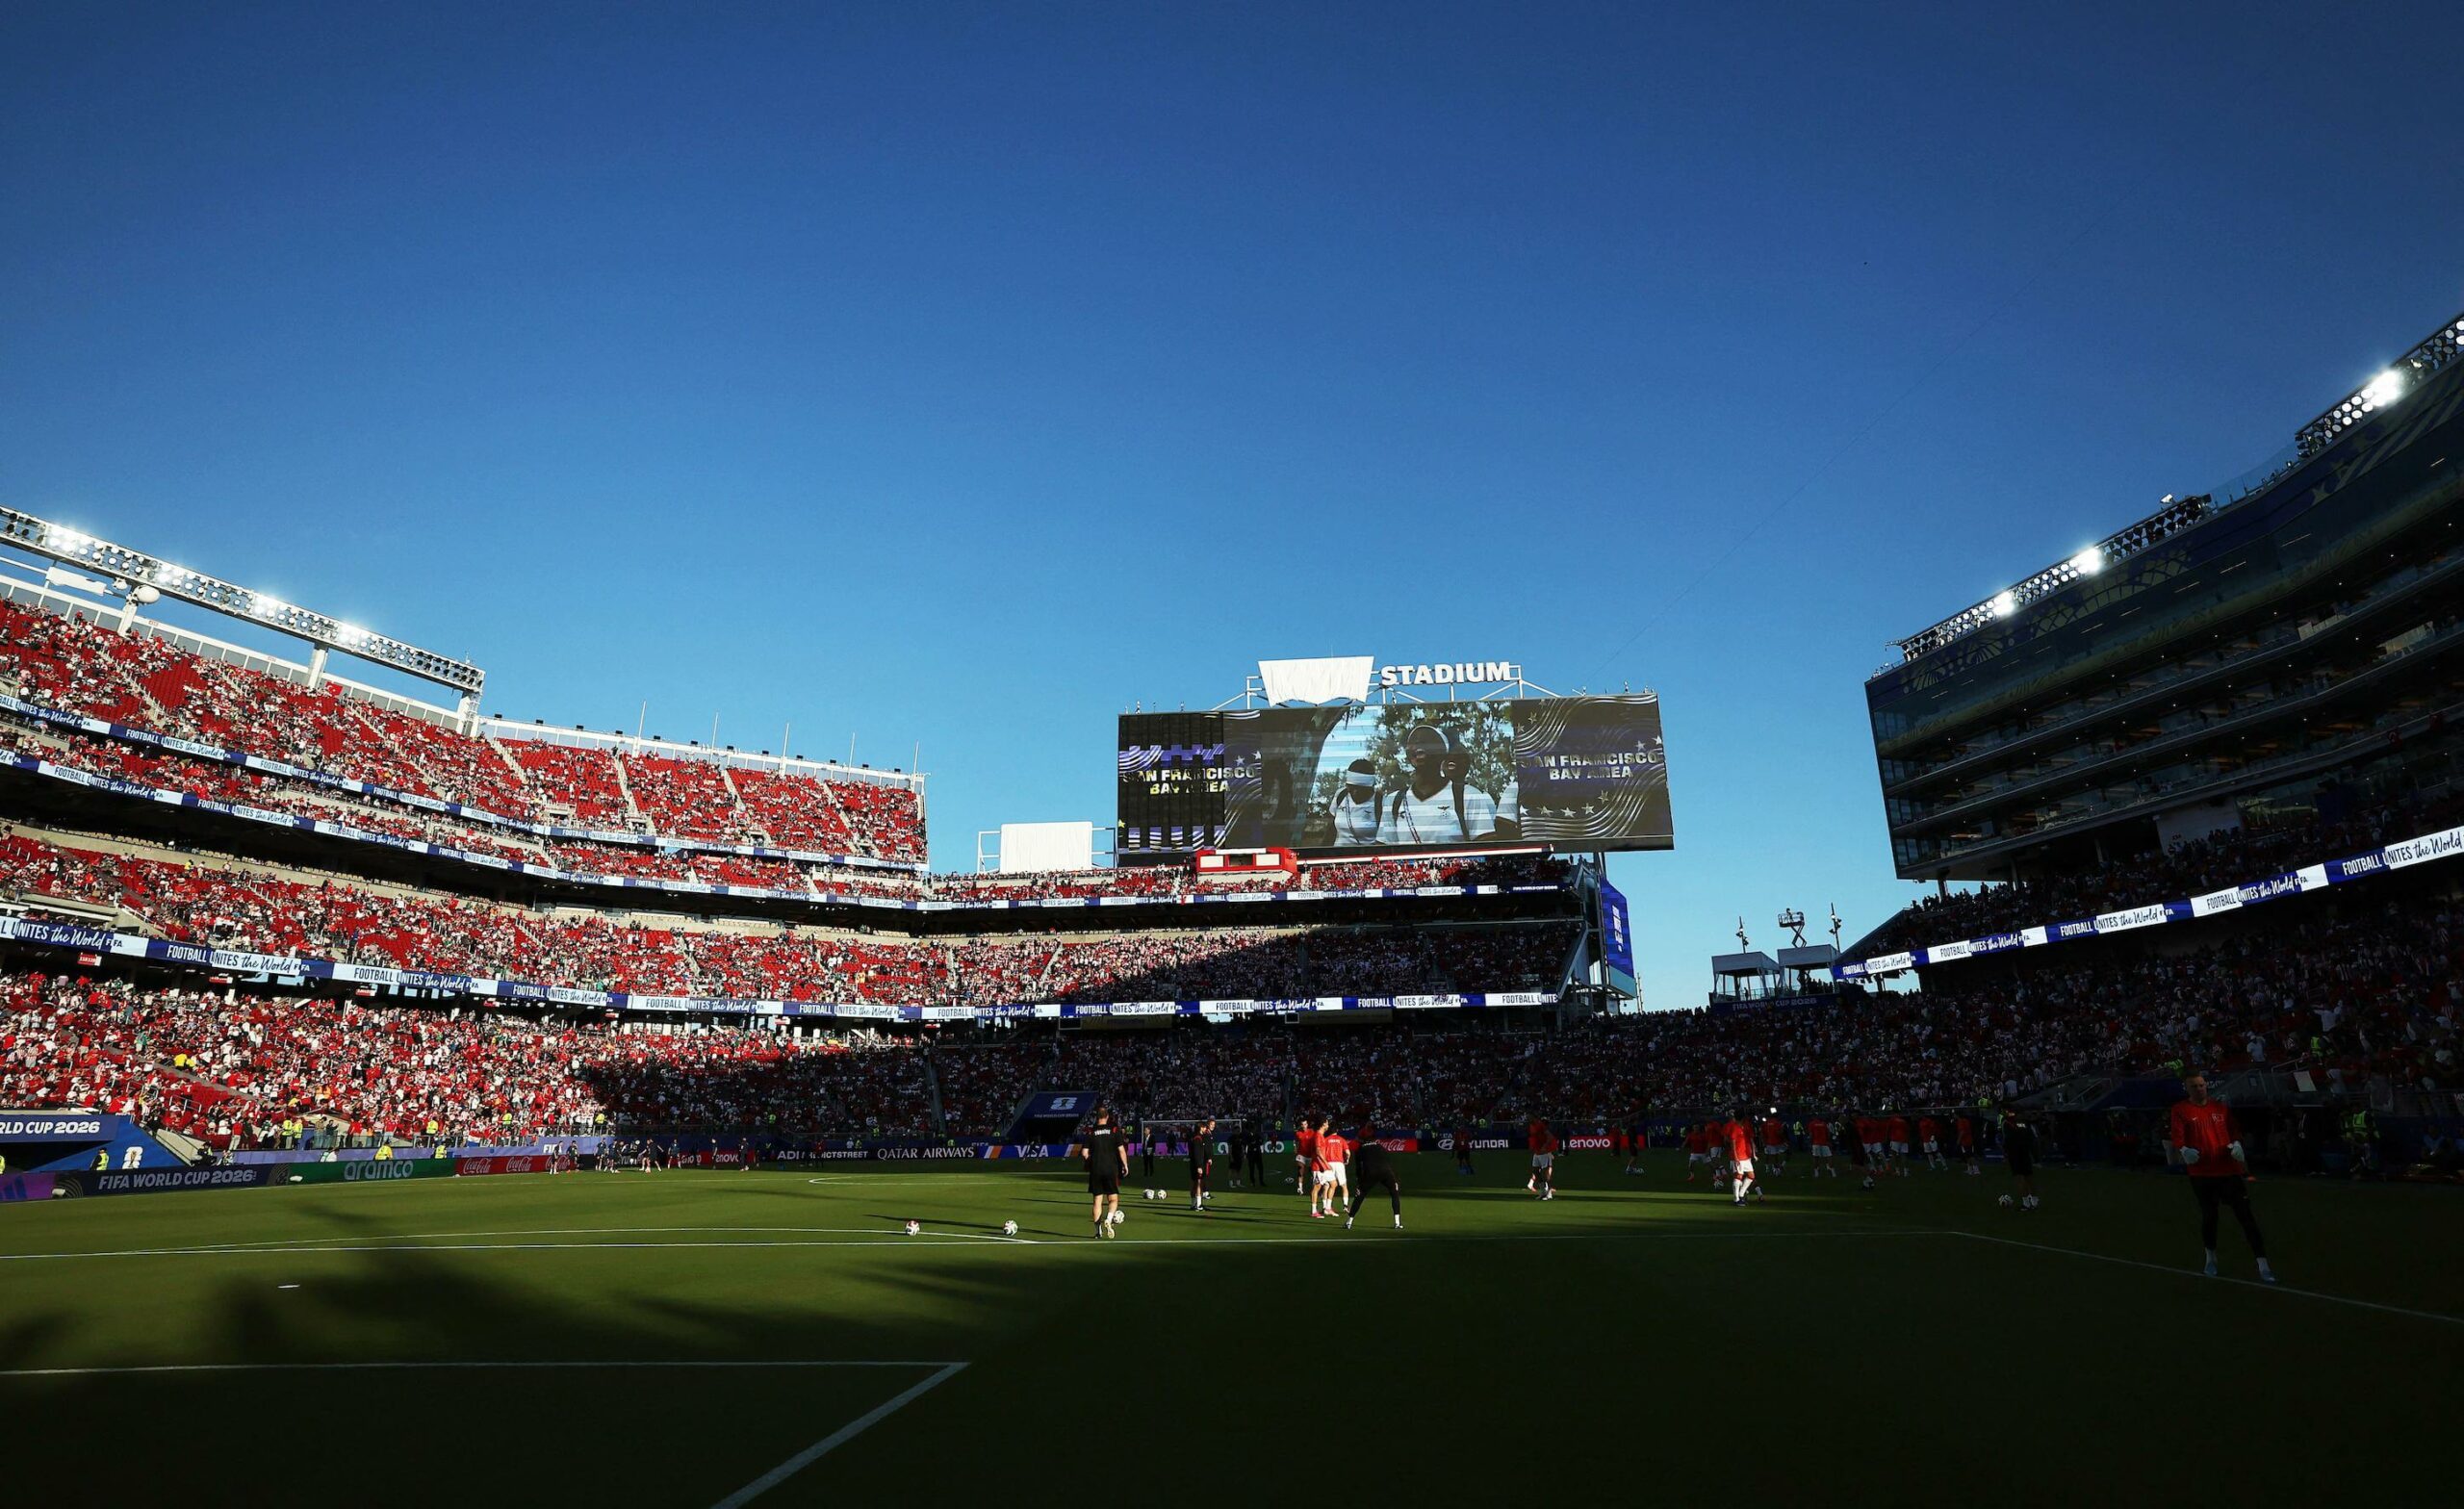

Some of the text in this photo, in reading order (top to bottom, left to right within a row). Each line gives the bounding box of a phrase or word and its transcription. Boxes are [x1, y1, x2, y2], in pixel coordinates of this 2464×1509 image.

[1381, 662, 1509, 685] STADIUM
[15, 701, 77, 725] UNITES the World
[126, 729, 159, 744] FOOTBALL
[162, 736, 184, 749] UNITES
[196, 744, 221, 757] World
[260, 759, 288, 773] FOOTBALL
[1559, 753, 1657, 767] FRANCISCO
[1549, 765, 1633, 780] BAY AREA
[54, 766, 151, 799] FOOTBALL UNITES the World
[372, 787, 398, 800] FOOTBALL
[197, 799, 230, 813] FOOTBALL
[232, 806, 254, 817] UNITES
[267, 811, 290, 825] World
[562, 829, 588, 838] FOOTBALL
[438, 847, 462, 859] FOOTBALL
[2342, 831, 2463, 876] FOOTBALL UNITES the World
[634, 880, 660, 889] FOOTBALL
[2206, 892, 2236, 910] FOOTBALL
[2236, 886, 2258, 903] UNITES
[2259, 881, 2272, 897] the
[2272, 875, 2295, 893] World
[2060, 922, 2093, 937] FOOTBALL
[2094, 917, 2118, 932] UNITES
[2119, 912, 2133, 926] the
[2133, 905, 2159, 924] World
[12, 922, 123, 950] UNITES the World FIFA
[1939, 934, 2018, 958] FOOTBALL UNITES the World
[167, 944, 207, 962] FOOTBALL
[209, 950, 239, 967] UNITES
[241, 954, 259, 968] the
[259, 957, 294, 974] World
[1842, 962, 1865, 976] FOOTBALL
[353, 967, 394, 983] FOOTBALL
[396, 972, 423, 985] UNITES
[424, 975, 440, 987] the
[440, 977, 465, 990] World
[512, 984, 603, 1005] FOOTBALL UNITES the World
[1502, 992, 1558, 1004] FOOTBALL UNITE
[646, 998, 752, 1013] FOOTBALL UNITES the World
[1075, 1002, 1170, 1015] FOOTBALL UNITES the World
[1216, 1002, 1248, 1010] FOOTBALL
[1249, 1000, 1273, 1010] UNITES
[1274, 1000, 1288, 1010] the
[1288, 998, 1311, 1010] World
[1357, 997, 1391, 1008] FOOTBALL
[1392, 997, 1417, 1007] UNITES
[1418, 996, 1430, 1007] the
[799, 1004, 832, 1015] FOOTBALL
[834, 1005, 857, 1015] UNITES
[870, 1007, 894, 1016] World
[937, 1005, 1030, 1017] FOOTBALL UNITES the World
[25, 1121, 54, 1134] CUP
[54, 1121, 100, 1134] 2026
[1014, 1144, 1049, 1158] VISA
[1468, 1139, 1509, 1149] YUNDAI
[877, 1146, 974, 1160] QATAR AIRWAYS
[344, 1161, 414, 1180] aramco
[98, 1169, 254, 1190] FIFA WORLD CUP 2026
